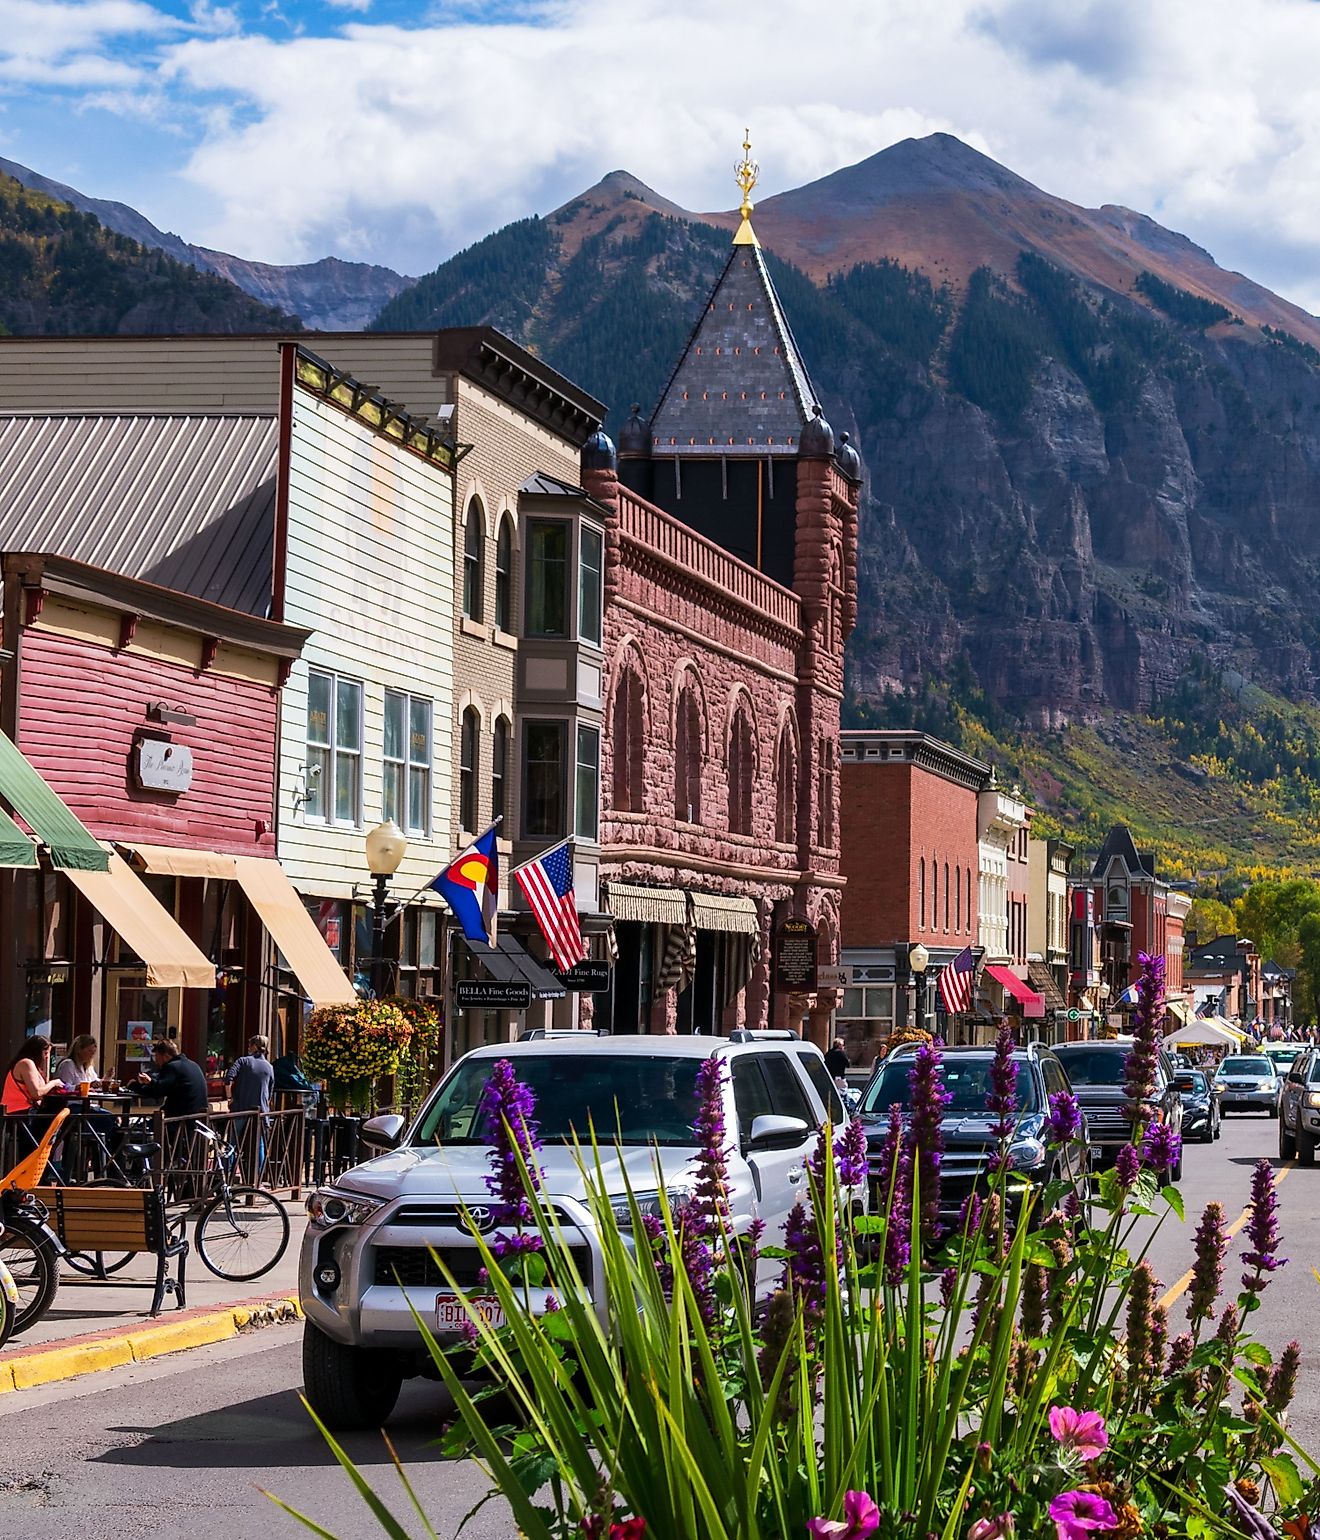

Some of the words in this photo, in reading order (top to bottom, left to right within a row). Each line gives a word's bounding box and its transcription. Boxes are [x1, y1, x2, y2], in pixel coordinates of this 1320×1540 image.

[551, 967, 572, 976] ZADI
[574, 967, 590, 976] Fine
[591, 968, 608, 978] Rugs
[459, 987, 487, 995] BELLA
[488, 987, 505, 995] Fine
[505, 987, 529, 996] Goods
